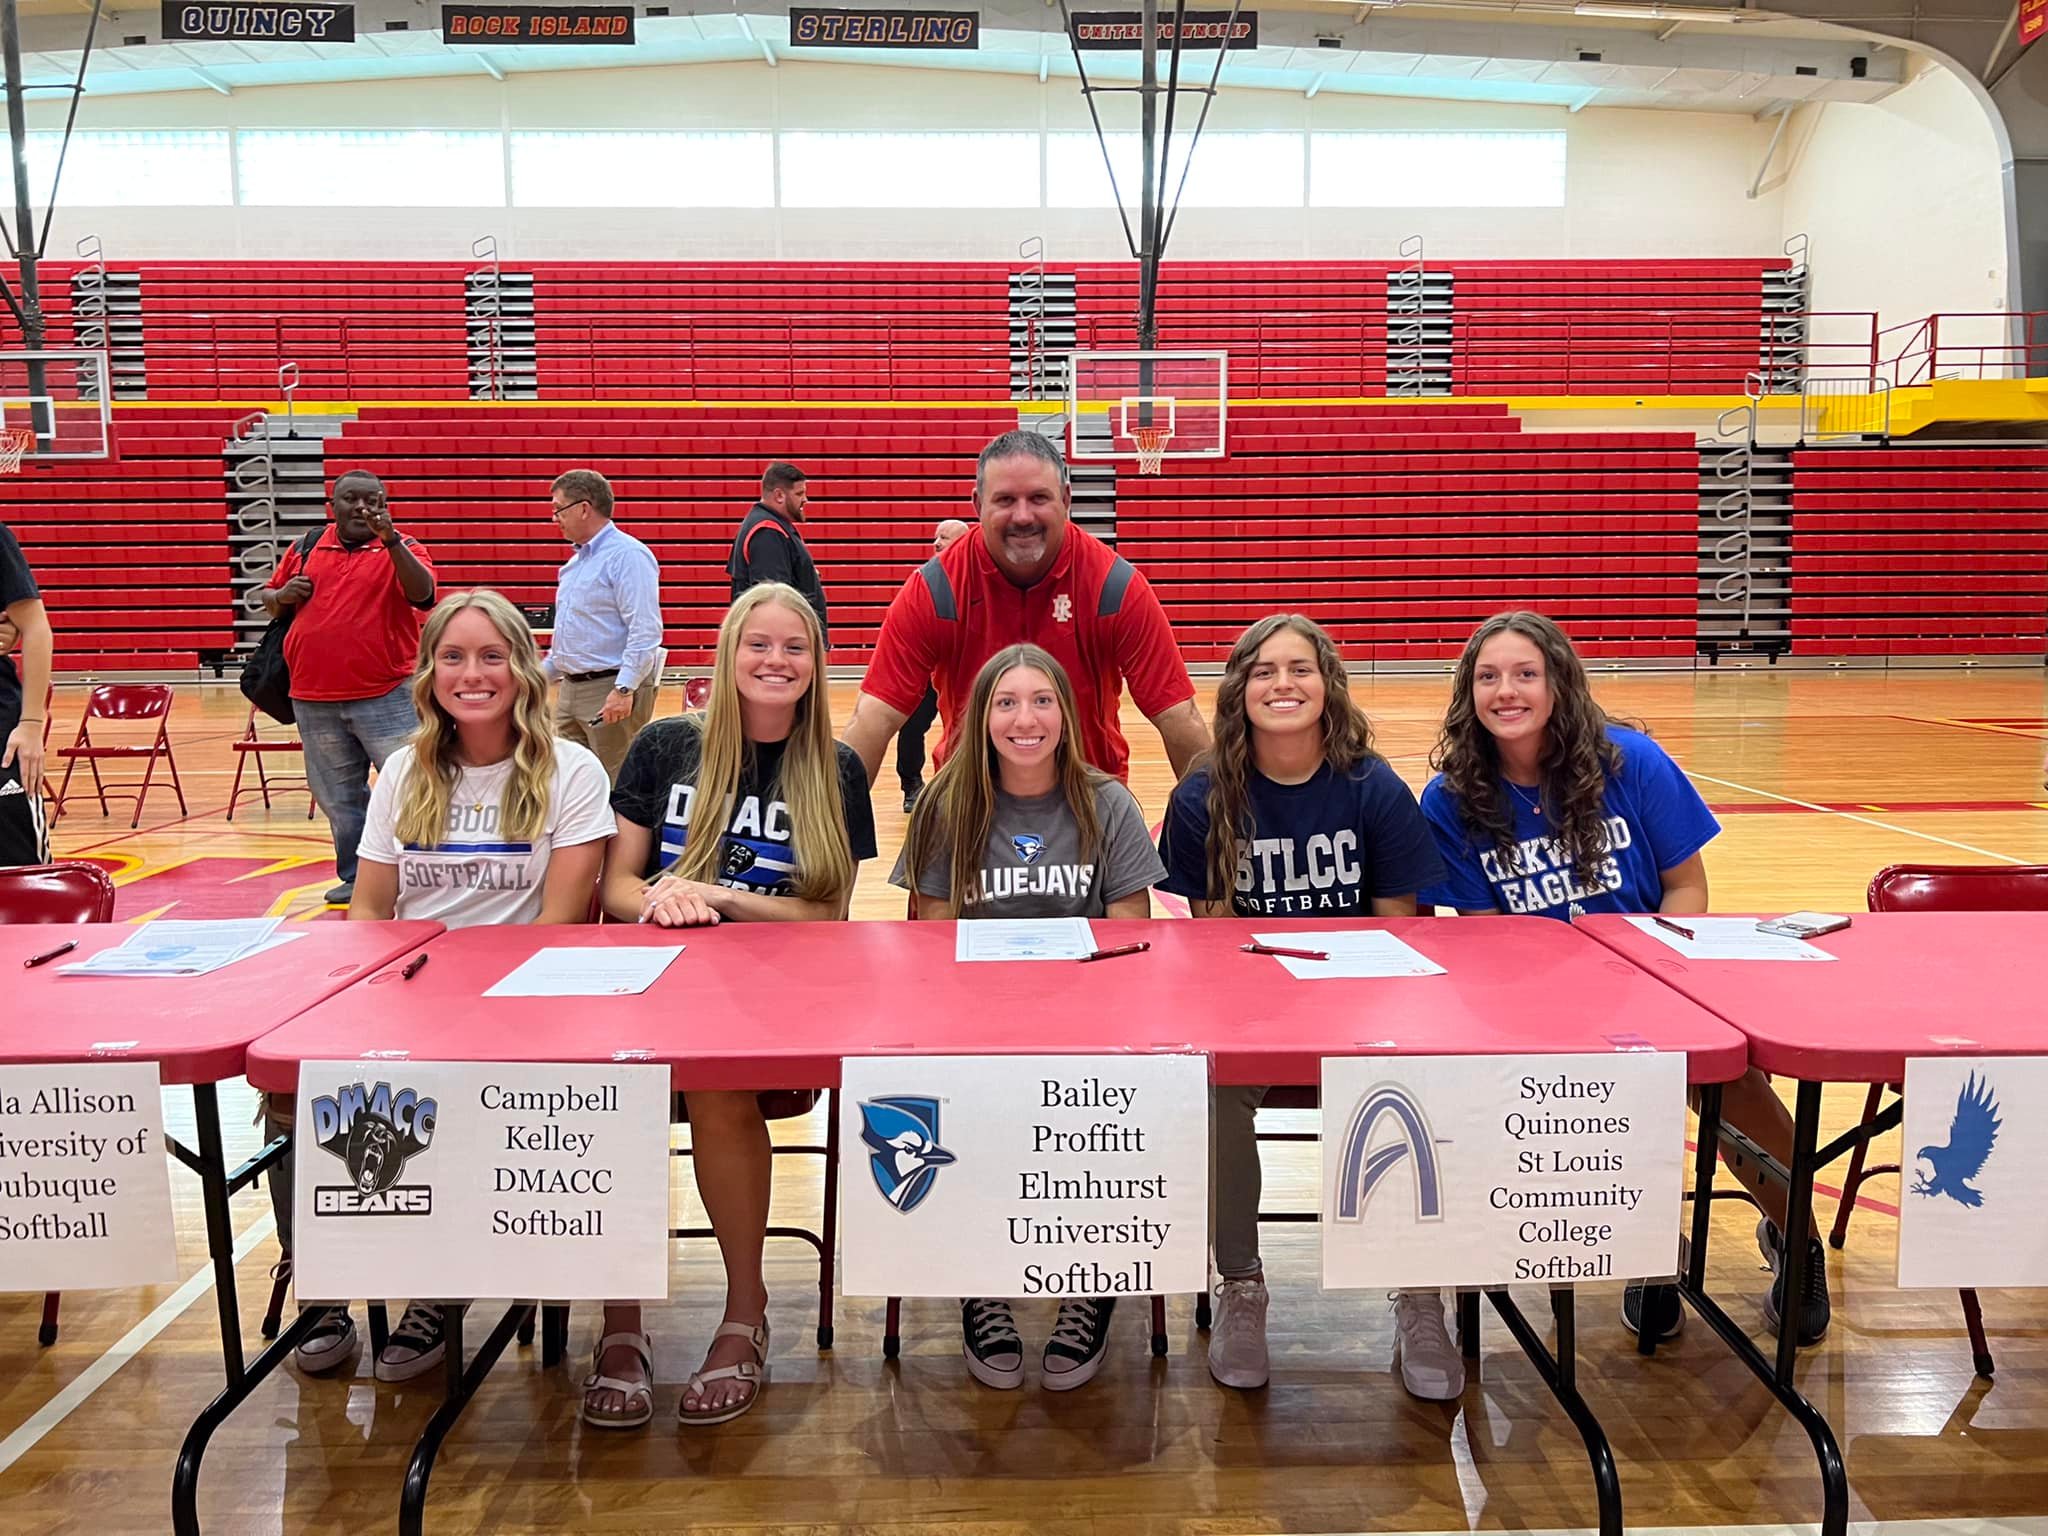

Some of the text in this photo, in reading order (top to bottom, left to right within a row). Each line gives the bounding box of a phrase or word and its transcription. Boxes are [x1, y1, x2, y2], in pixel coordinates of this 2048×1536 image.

[181, 6, 335, 36] QUINCY
[450, 15, 629, 36] ROCK ISLAND
[798, 15, 973, 42] STERLING
[1234, 829, 1361, 894] STLCC
[1479, 815, 1632, 882] KIRKWD
[404, 860, 533, 891] SOFTBALL
[29, 1087, 137, 1115] Allison
[481, 1085, 618, 1117] Campbell
[1040, 1078, 1137, 1115] Bailey
[1520, 1075, 1616, 1105] Sydney
[311, 1081, 438, 1147] DMACC
[1504, 1112, 1631, 1140] Quinones
[116, 1128, 148, 1155] of
[505, 1125, 595, 1157] Kelley
[1032, 1123, 1146, 1152] Proffitt
[1518, 1148, 1623, 1174] St Louis
[0, 1171, 117, 1203] ubuque
[493, 1168, 613, 1194] DMACC
[1019, 1171, 1168, 1200] Elmhurst
[316, 1190, 431, 1213] BEARS
[1489, 1184, 1643, 1211] Community
[0, 1212, 109, 1241] Softball
[493, 1210, 603, 1236] Softball
[1007, 1216, 1171, 1249] University
[1518, 1220, 1612, 1246] College
[1023, 1262, 1153, 1294] Softball
[1514, 1254, 1612, 1280] Softball
